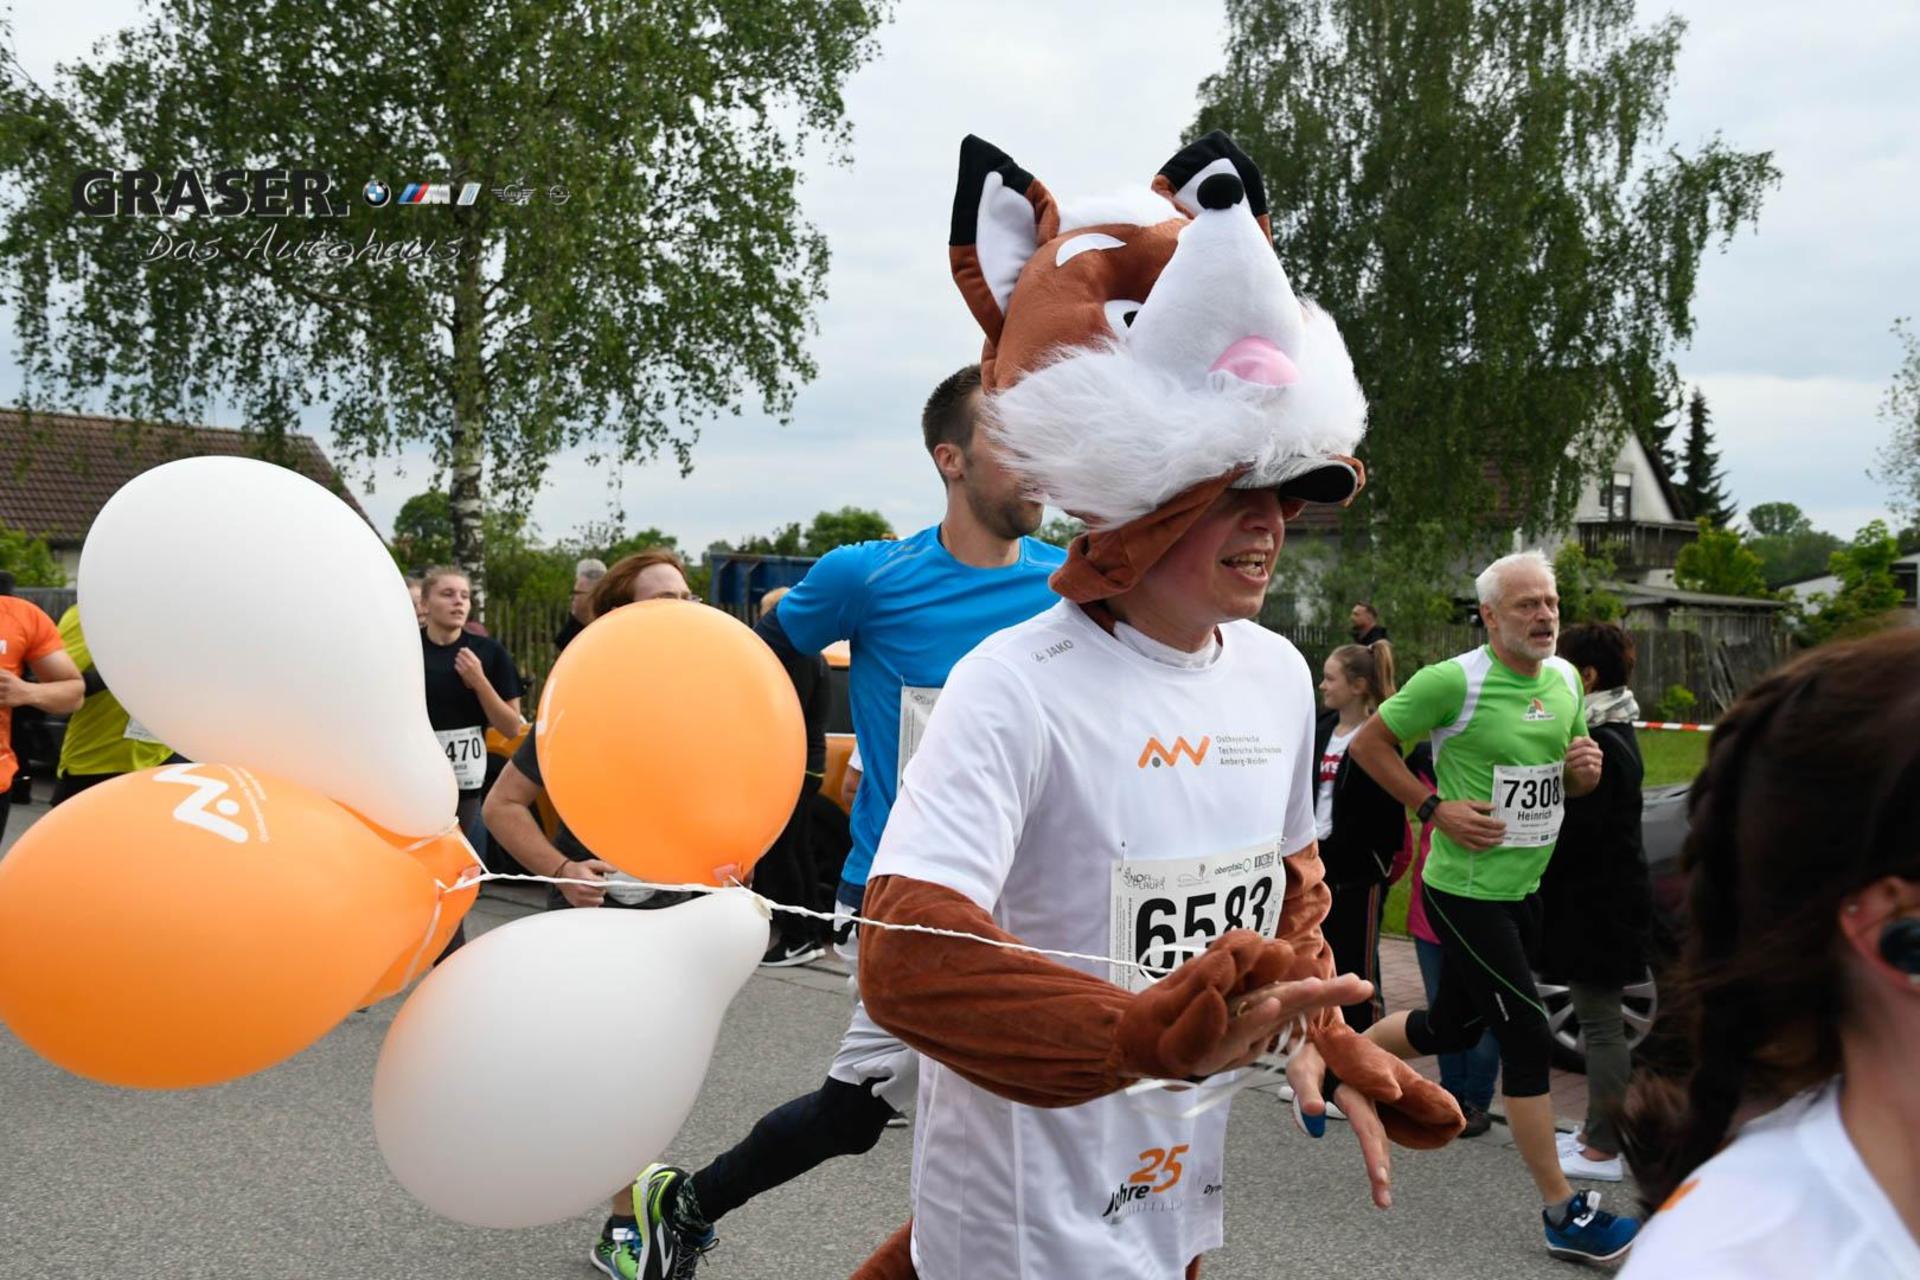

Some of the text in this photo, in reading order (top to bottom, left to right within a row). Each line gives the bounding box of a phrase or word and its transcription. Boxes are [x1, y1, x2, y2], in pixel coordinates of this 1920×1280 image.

[1045, 639, 1075, 660] JAKO
[1503, 775, 1561, 809] 7308
[1136, 876, 1273, 979] 6583
[1128, 1143, 1190, 1193] 25
[1102, 1182, 1151, 1217] Jahre
